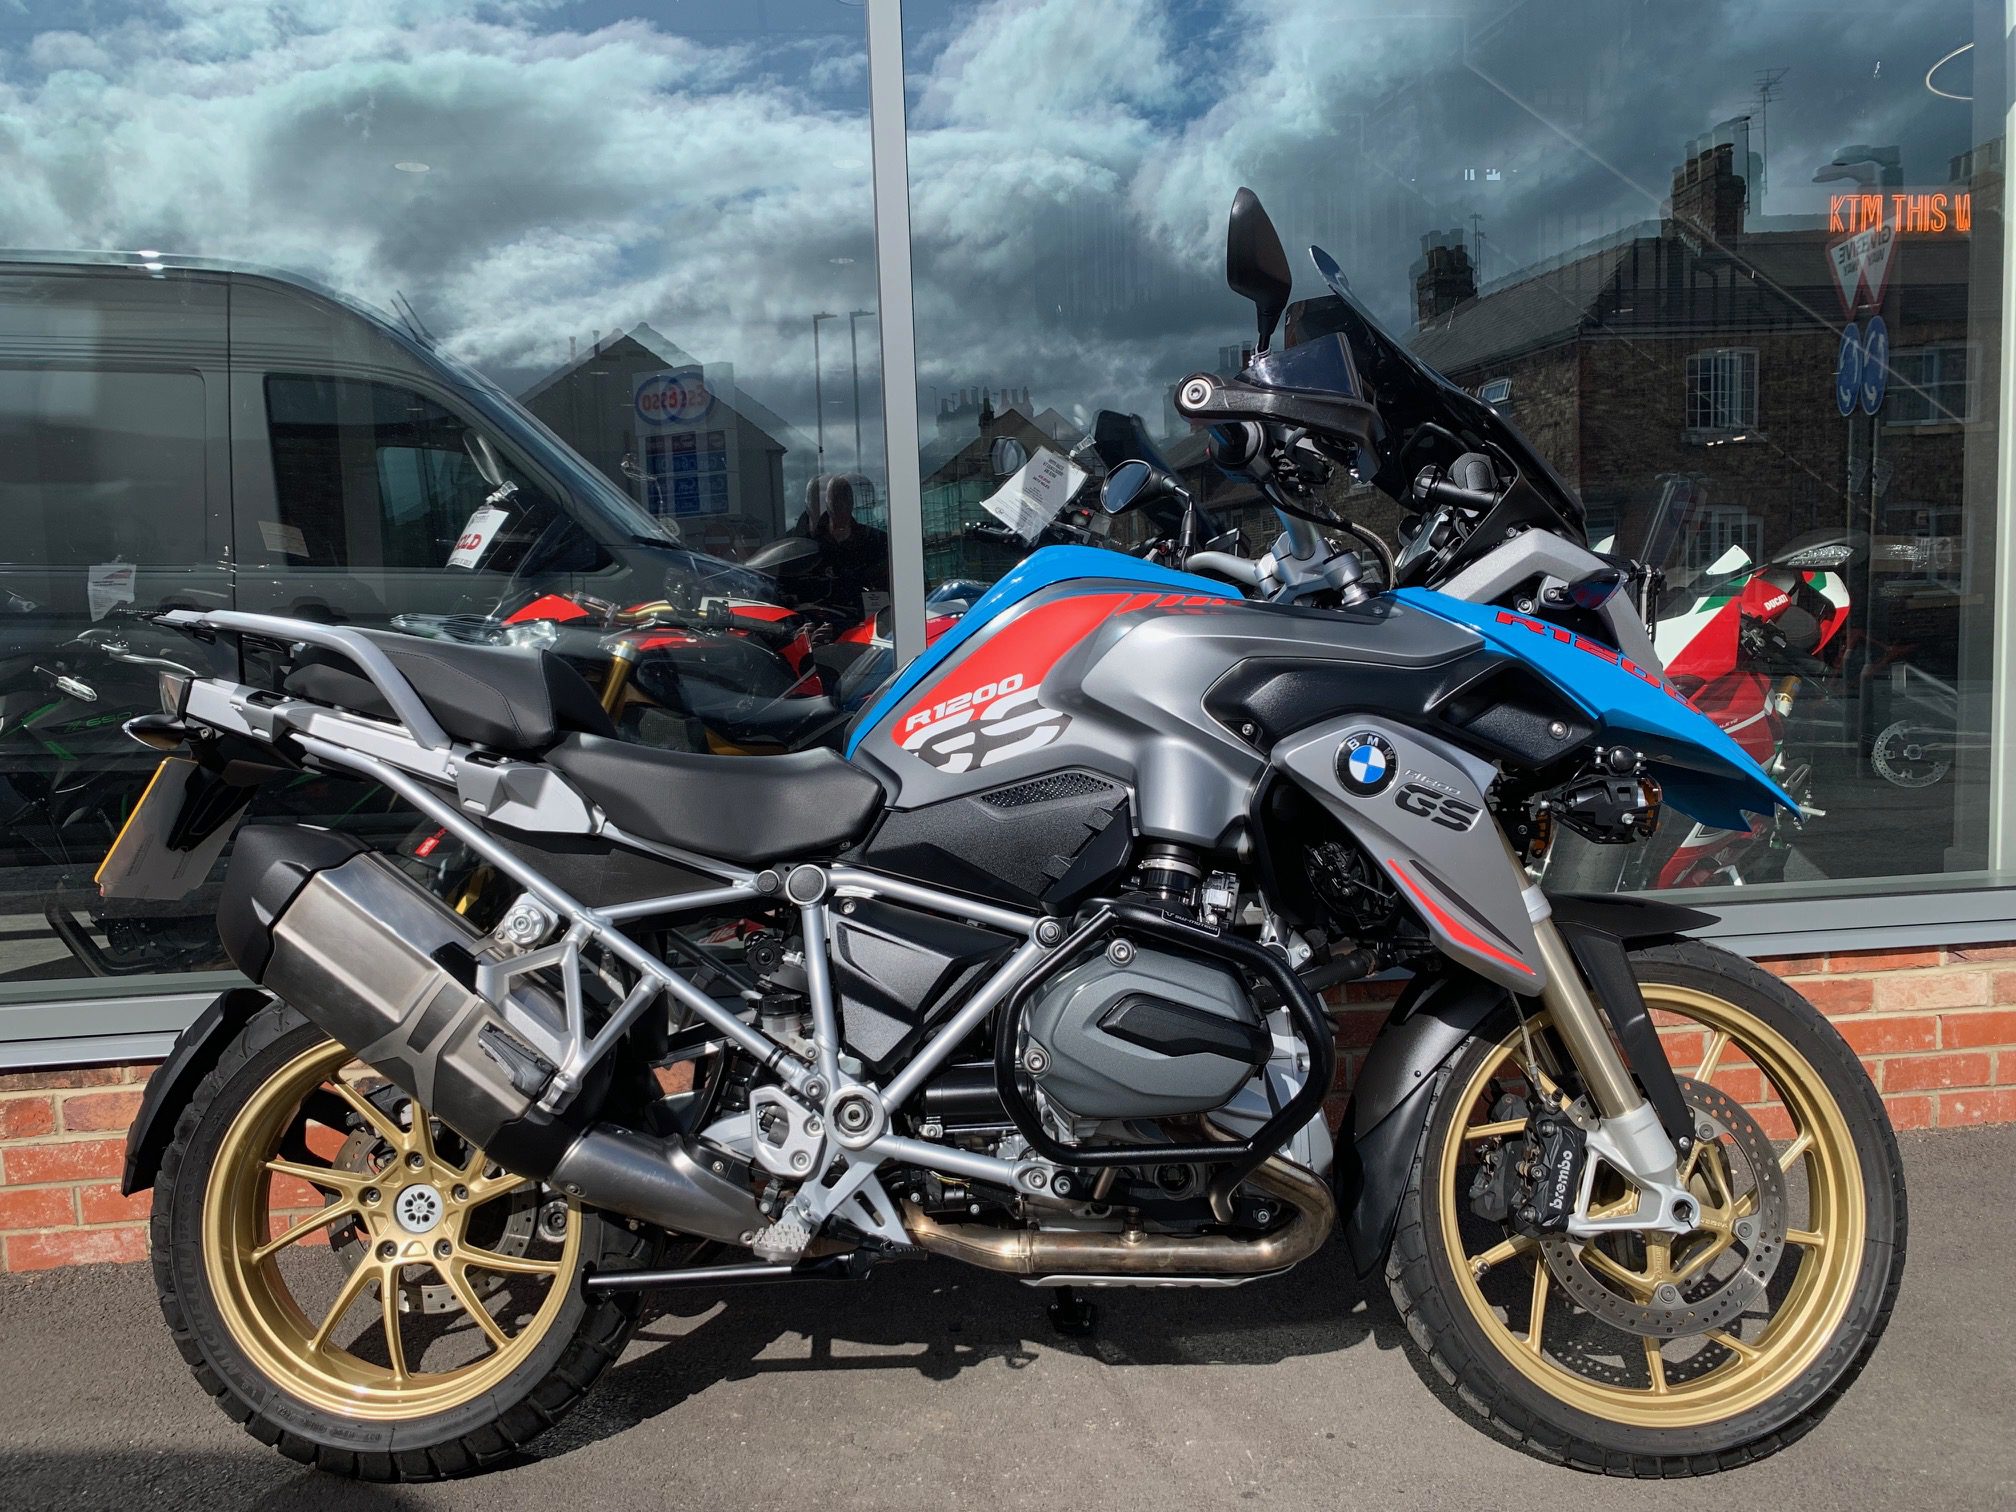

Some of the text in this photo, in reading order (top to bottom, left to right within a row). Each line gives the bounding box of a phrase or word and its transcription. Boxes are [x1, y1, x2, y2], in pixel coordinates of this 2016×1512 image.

[1829, 193, 1883, 233] KTM
[1891, 193, 1948, 232] THIS
[1763, 594, 1789, 611] DUCATI
[902, 683, 1063, 773] GS
[905, 673, 1024, 732] R1200
[1346, 735, 1395, 762] BMW
[1394, 783, 1480, 831] GS
[1549, 1150, 1573, 1209] brembo
[174, 1249, 243, 1378] MICHELIN
